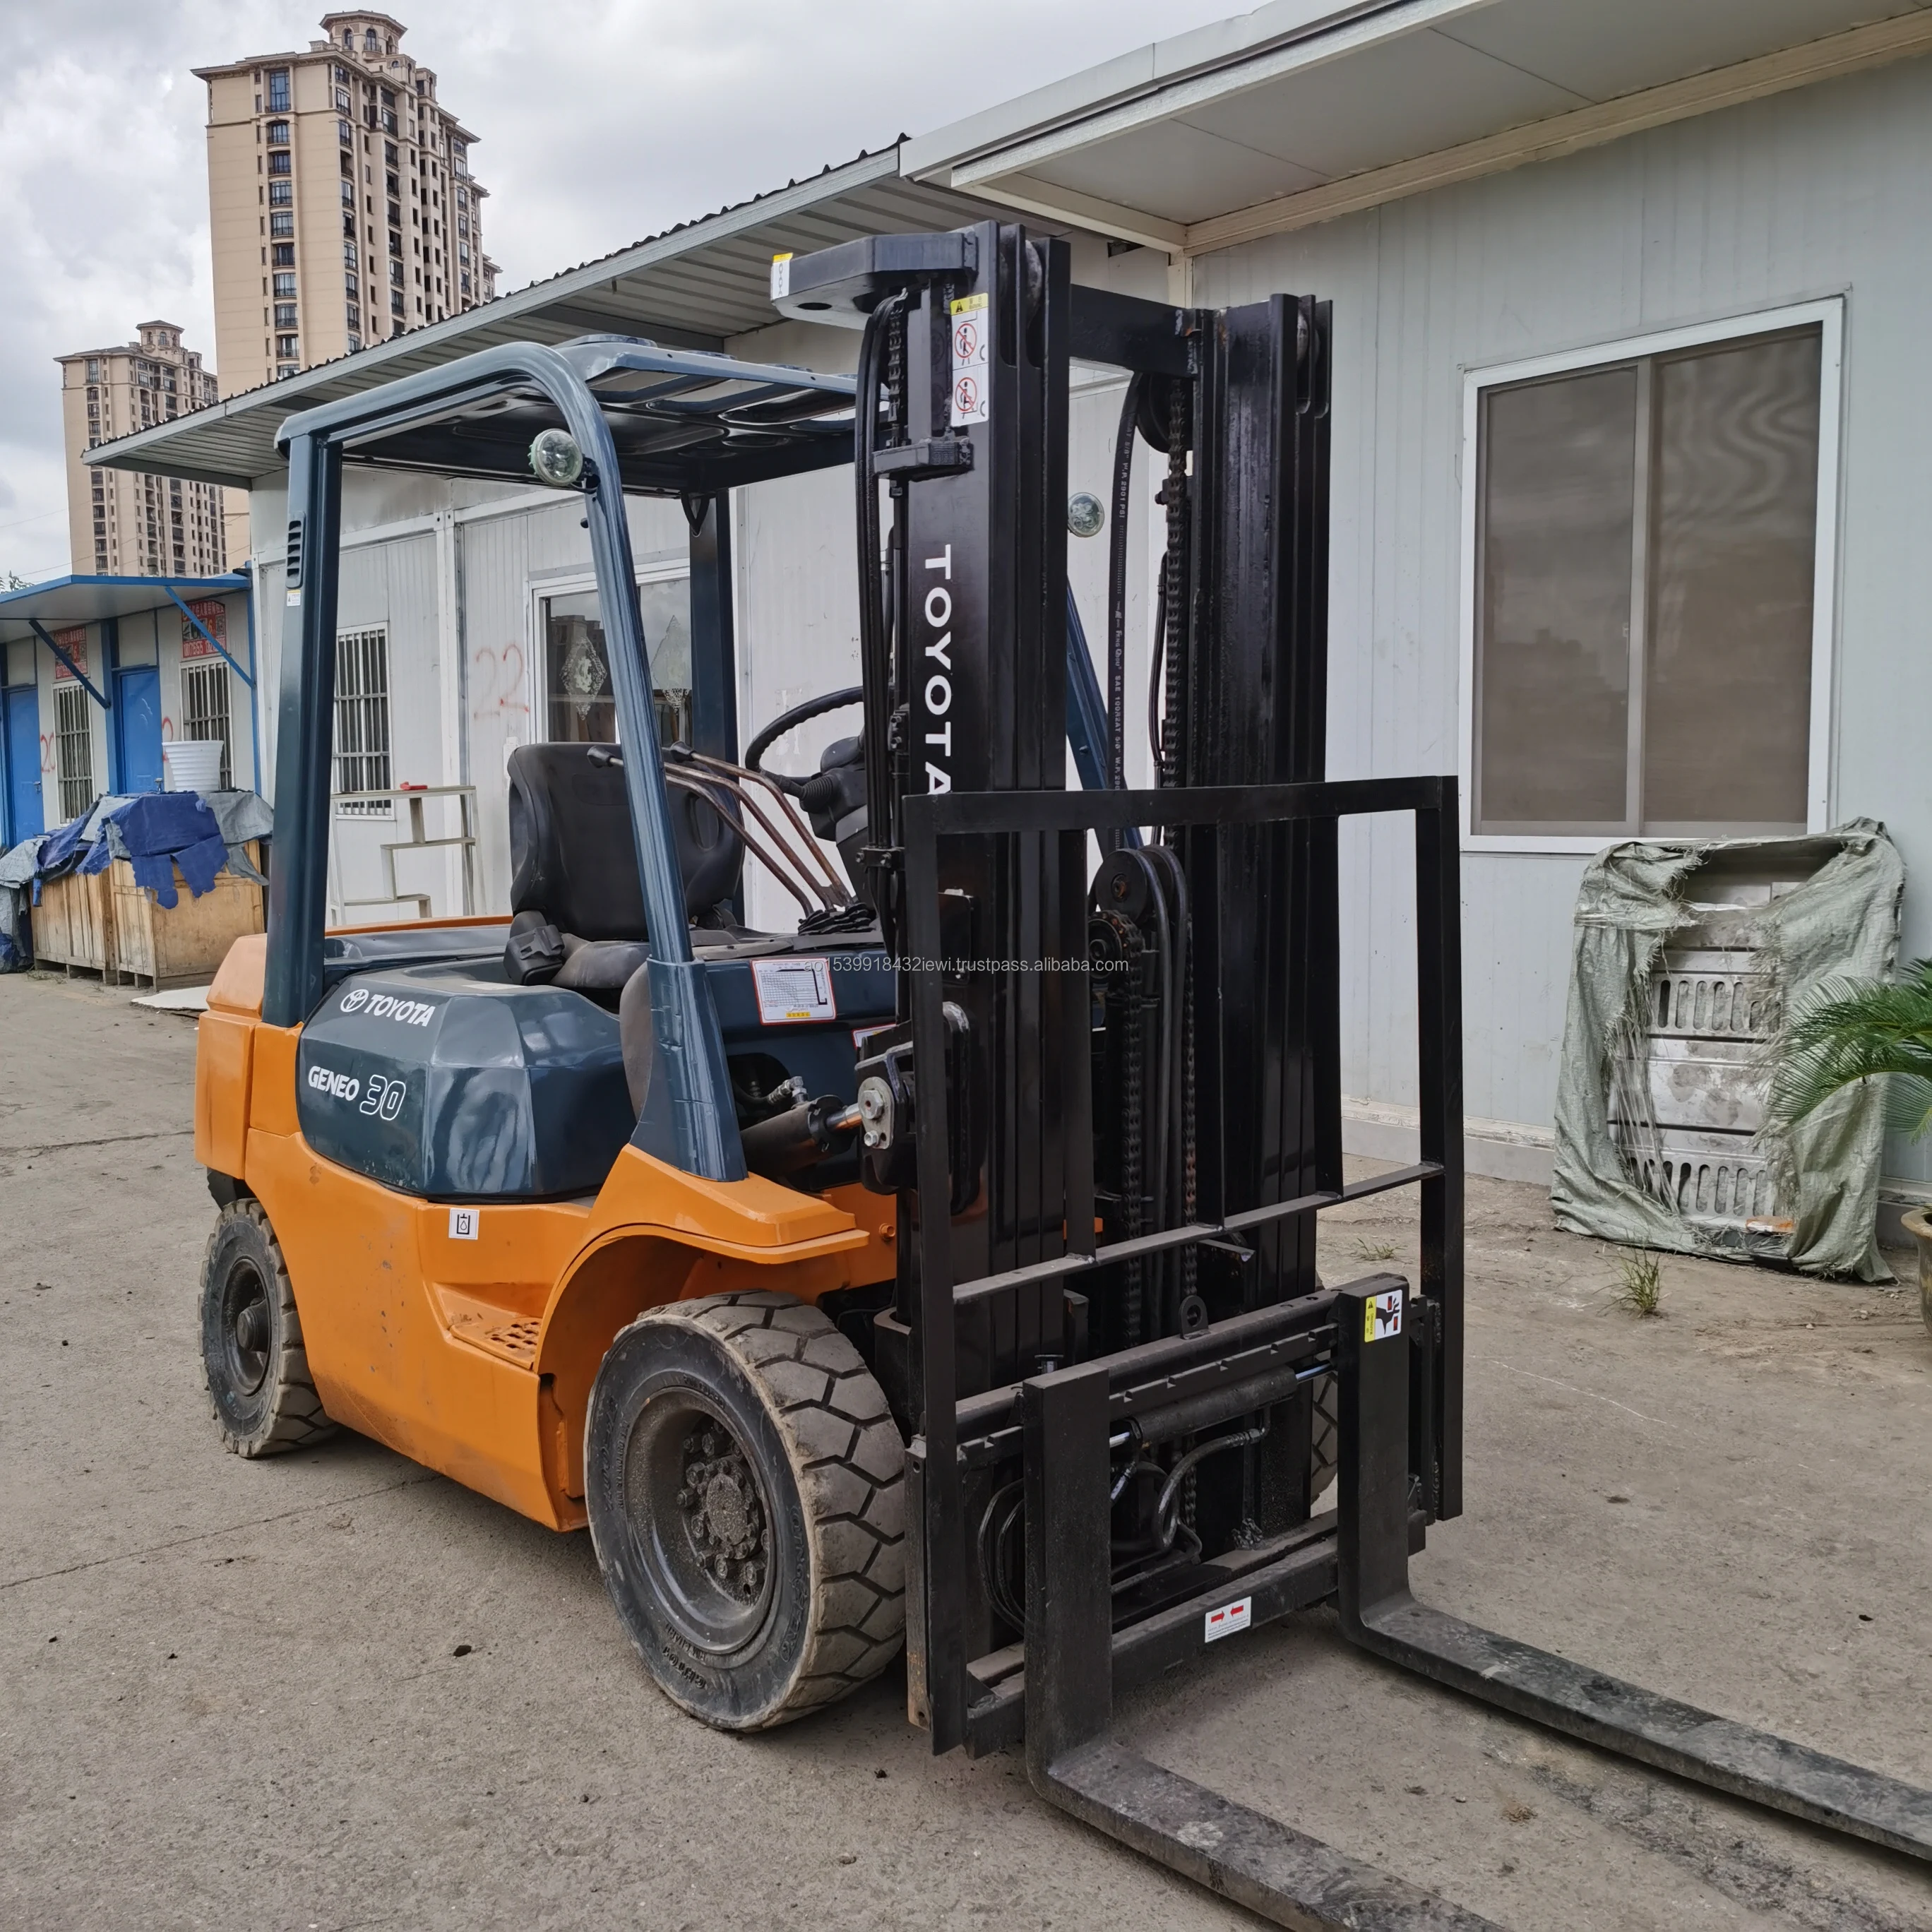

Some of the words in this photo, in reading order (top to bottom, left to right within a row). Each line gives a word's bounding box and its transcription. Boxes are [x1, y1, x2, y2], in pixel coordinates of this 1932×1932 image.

[925, 544, 952, 795] TOYOTA
[364, 994, 436, 1027] TOYOTA
[308, 1066, 360, 1102] GENEO
[359, 1074, 407, 1121] 30
